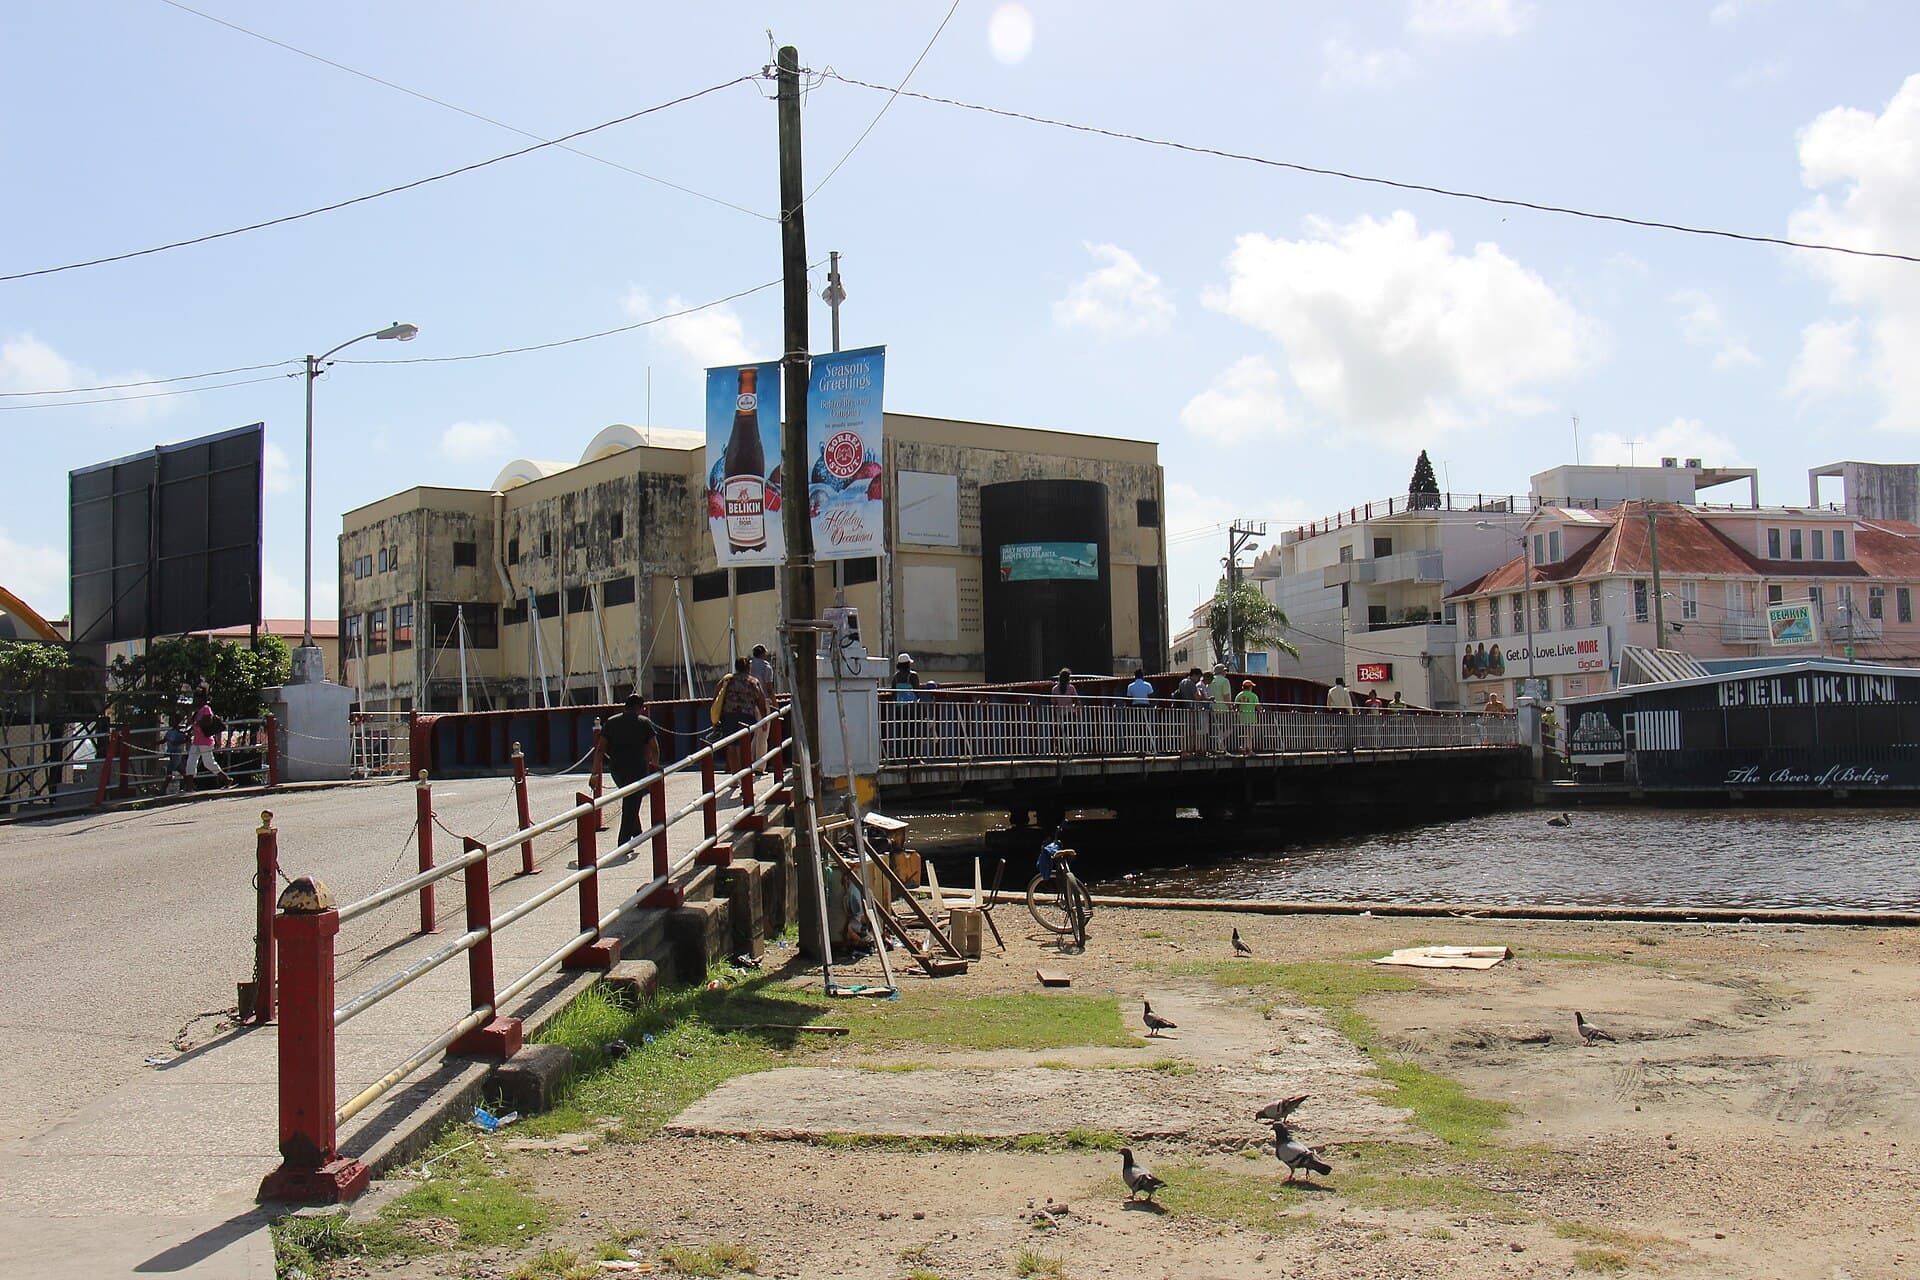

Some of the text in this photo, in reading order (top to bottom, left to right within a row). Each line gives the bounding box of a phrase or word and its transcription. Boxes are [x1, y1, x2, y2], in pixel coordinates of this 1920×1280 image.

[824, 358, 870, 377] Season's
[819, 375, 871, 391] Greetings
[828, 434, 860, 452] SORREL
[829, 459, 859, 475] STOUT
[728, 502, 761, 514] BELIKIN
[1771, 608, 1808, 620] BELIKIN
[1360, 668, 1385, 680] Best
[1718, 676, 1896, 706] BELIKIN
[1573, 741, 1622, 751] BELIKIN
[1723, 764, 1889, 785] The Beer of Belize
